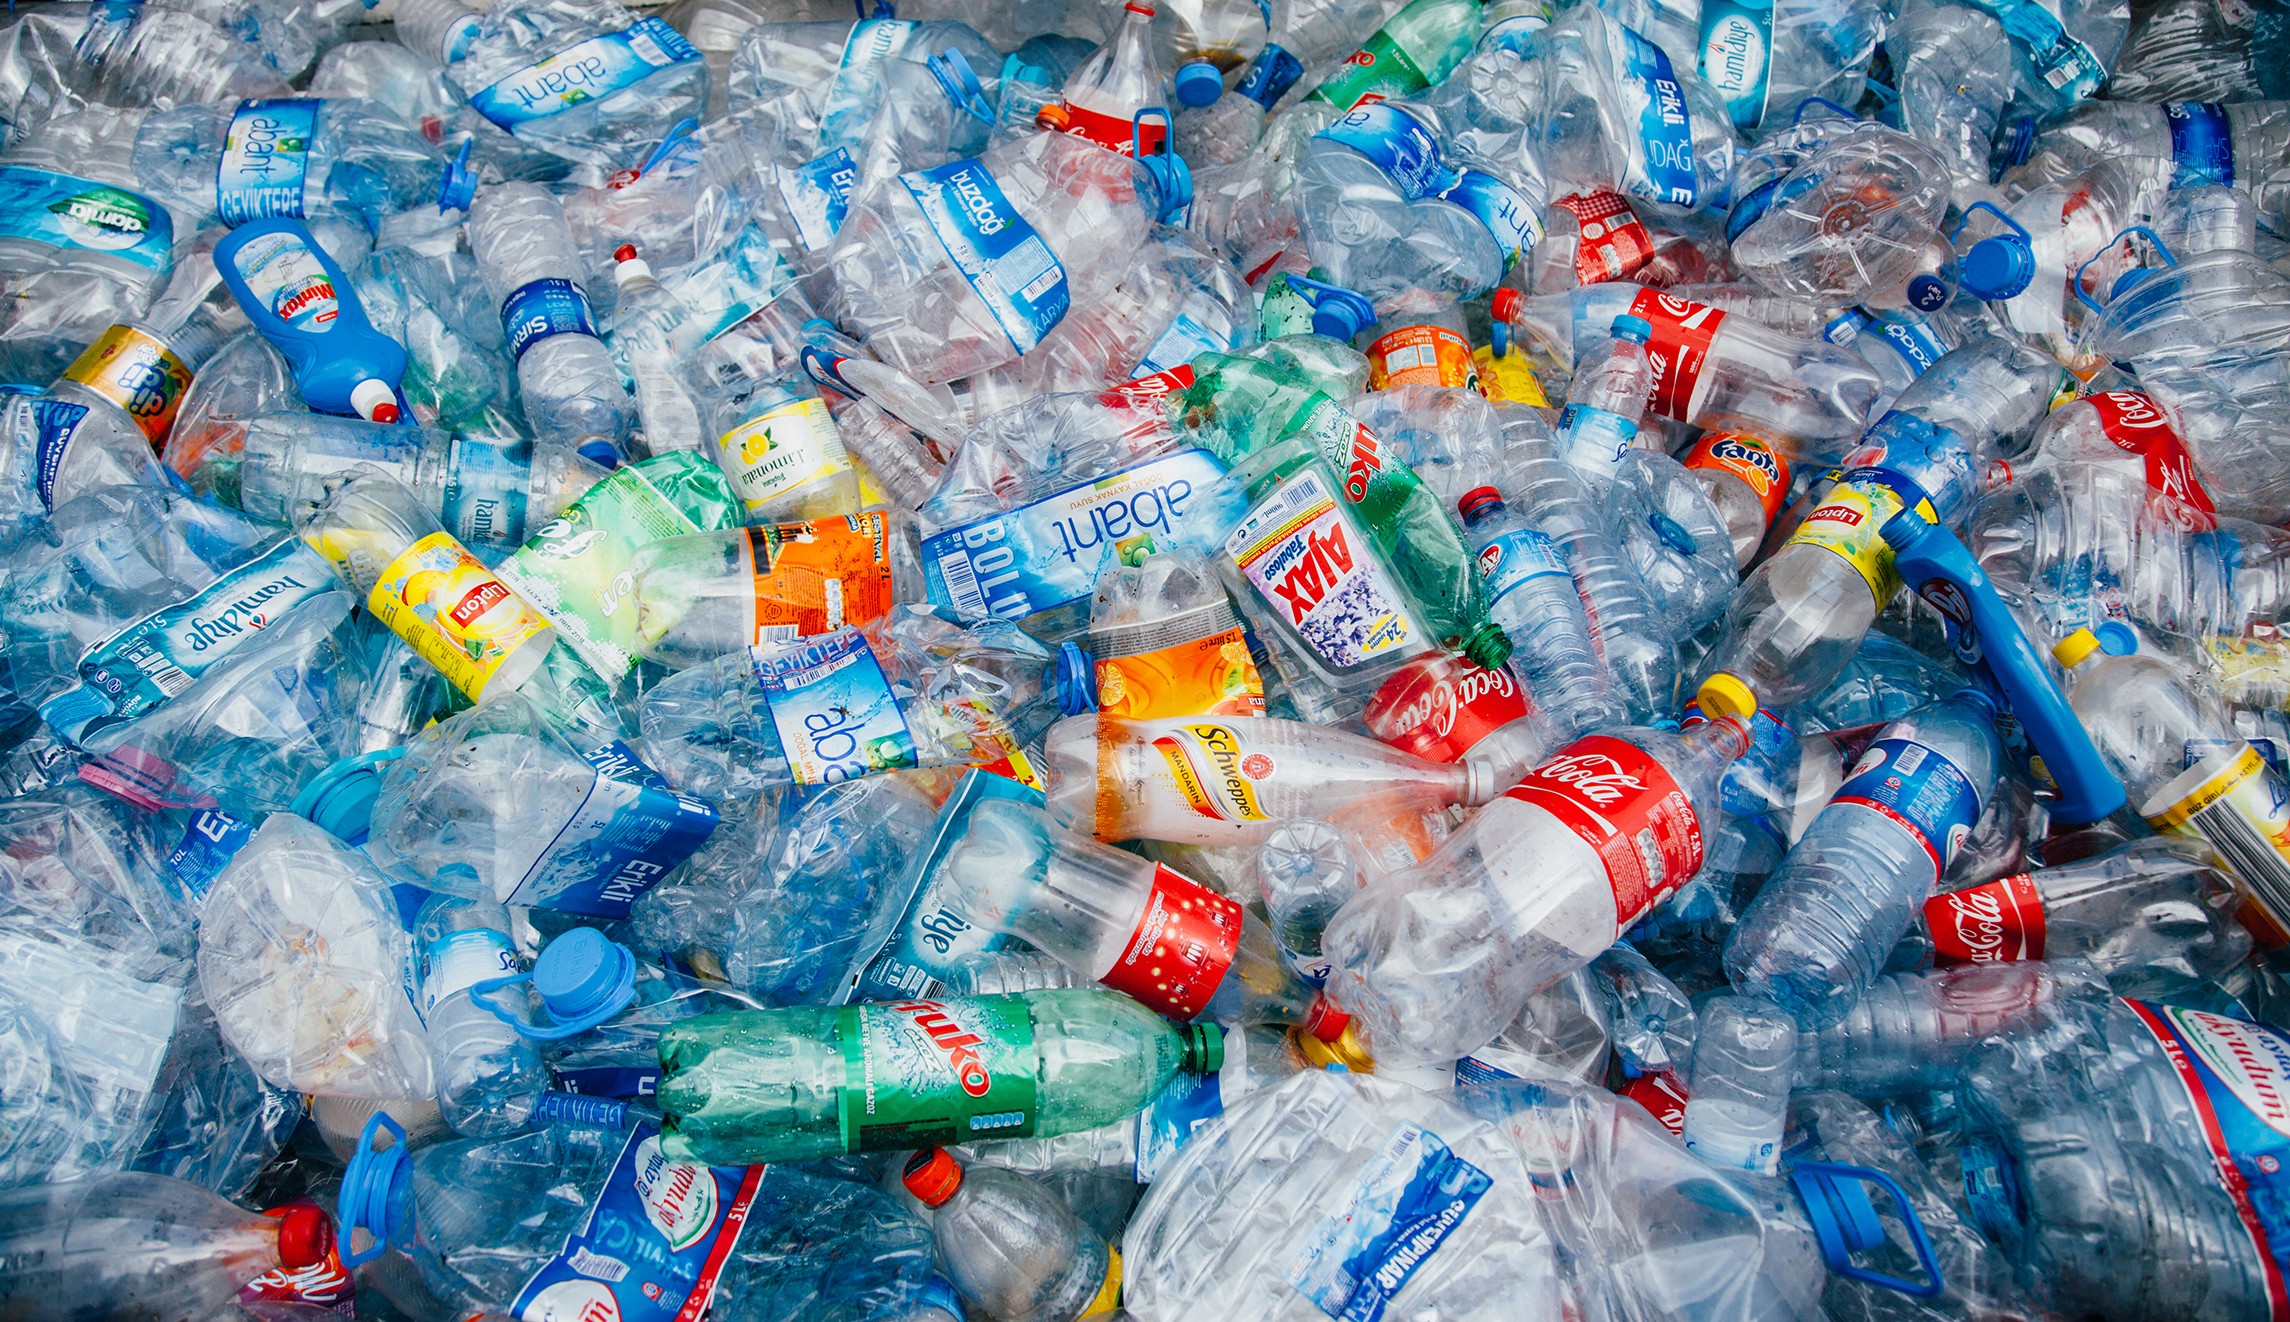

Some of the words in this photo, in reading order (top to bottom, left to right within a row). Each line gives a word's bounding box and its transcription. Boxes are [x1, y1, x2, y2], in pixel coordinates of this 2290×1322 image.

[1717, 20, 1757, 93] hamidiye
[512, 56, 606, 108] abant
[1655, 78, 1687, 128] Erikli
[240, 118, 280, 174] abant
[70, 203, 143, 231] damla
[949, 169, 1005, 235] buzdağı
[1500, 197, 1537, 252] ant
[279, 283, 338, 321] Mintax
[1884, 322, 1930, 371] zdağı
[741, 449, 803, 486] Limonata
[763, 472, 787, 488] Tropicana
[1135, 472, 1164, 490] DOĞAL
[1710, 439, 1781, 486] Fanta
[1069, 495, 1094, 511] SUYU
[1094, 482, 1132, 501] KAYNAK
[1052, 479, 1193, 564] abant
[1809, 507, 1858, 525] Lipton
[961, 518, 1033, 621] BOLU
[1264, 533, 1309, 581] Fabuloso
[1274, 521, 1355, 626] AJAX
[184, 574, 307, 653] hamidiye
[455, 582, 509, 621] Lipton
[1208, 635, 1226, 648] litre
[1383, 621, 1403, 642] 24
[1170, 751, 1202, 805] MANDARIN
[1195, 728, 1253, 817] Schweppes
[2186, 800, 2204, 815] BUZ
[2202, 789, 2221, 805] GİBİ
[170, 848, 188, 867] 10L
[600, 858, 664, 905] Erikli
[861, 1023, 870, 1047] MEYVE
[2193, 1011, 2285, 1121] akyudum
[865, 1088, 875, 1114] GAZOZ
[652, 1160, 701, 1230] akyudu
